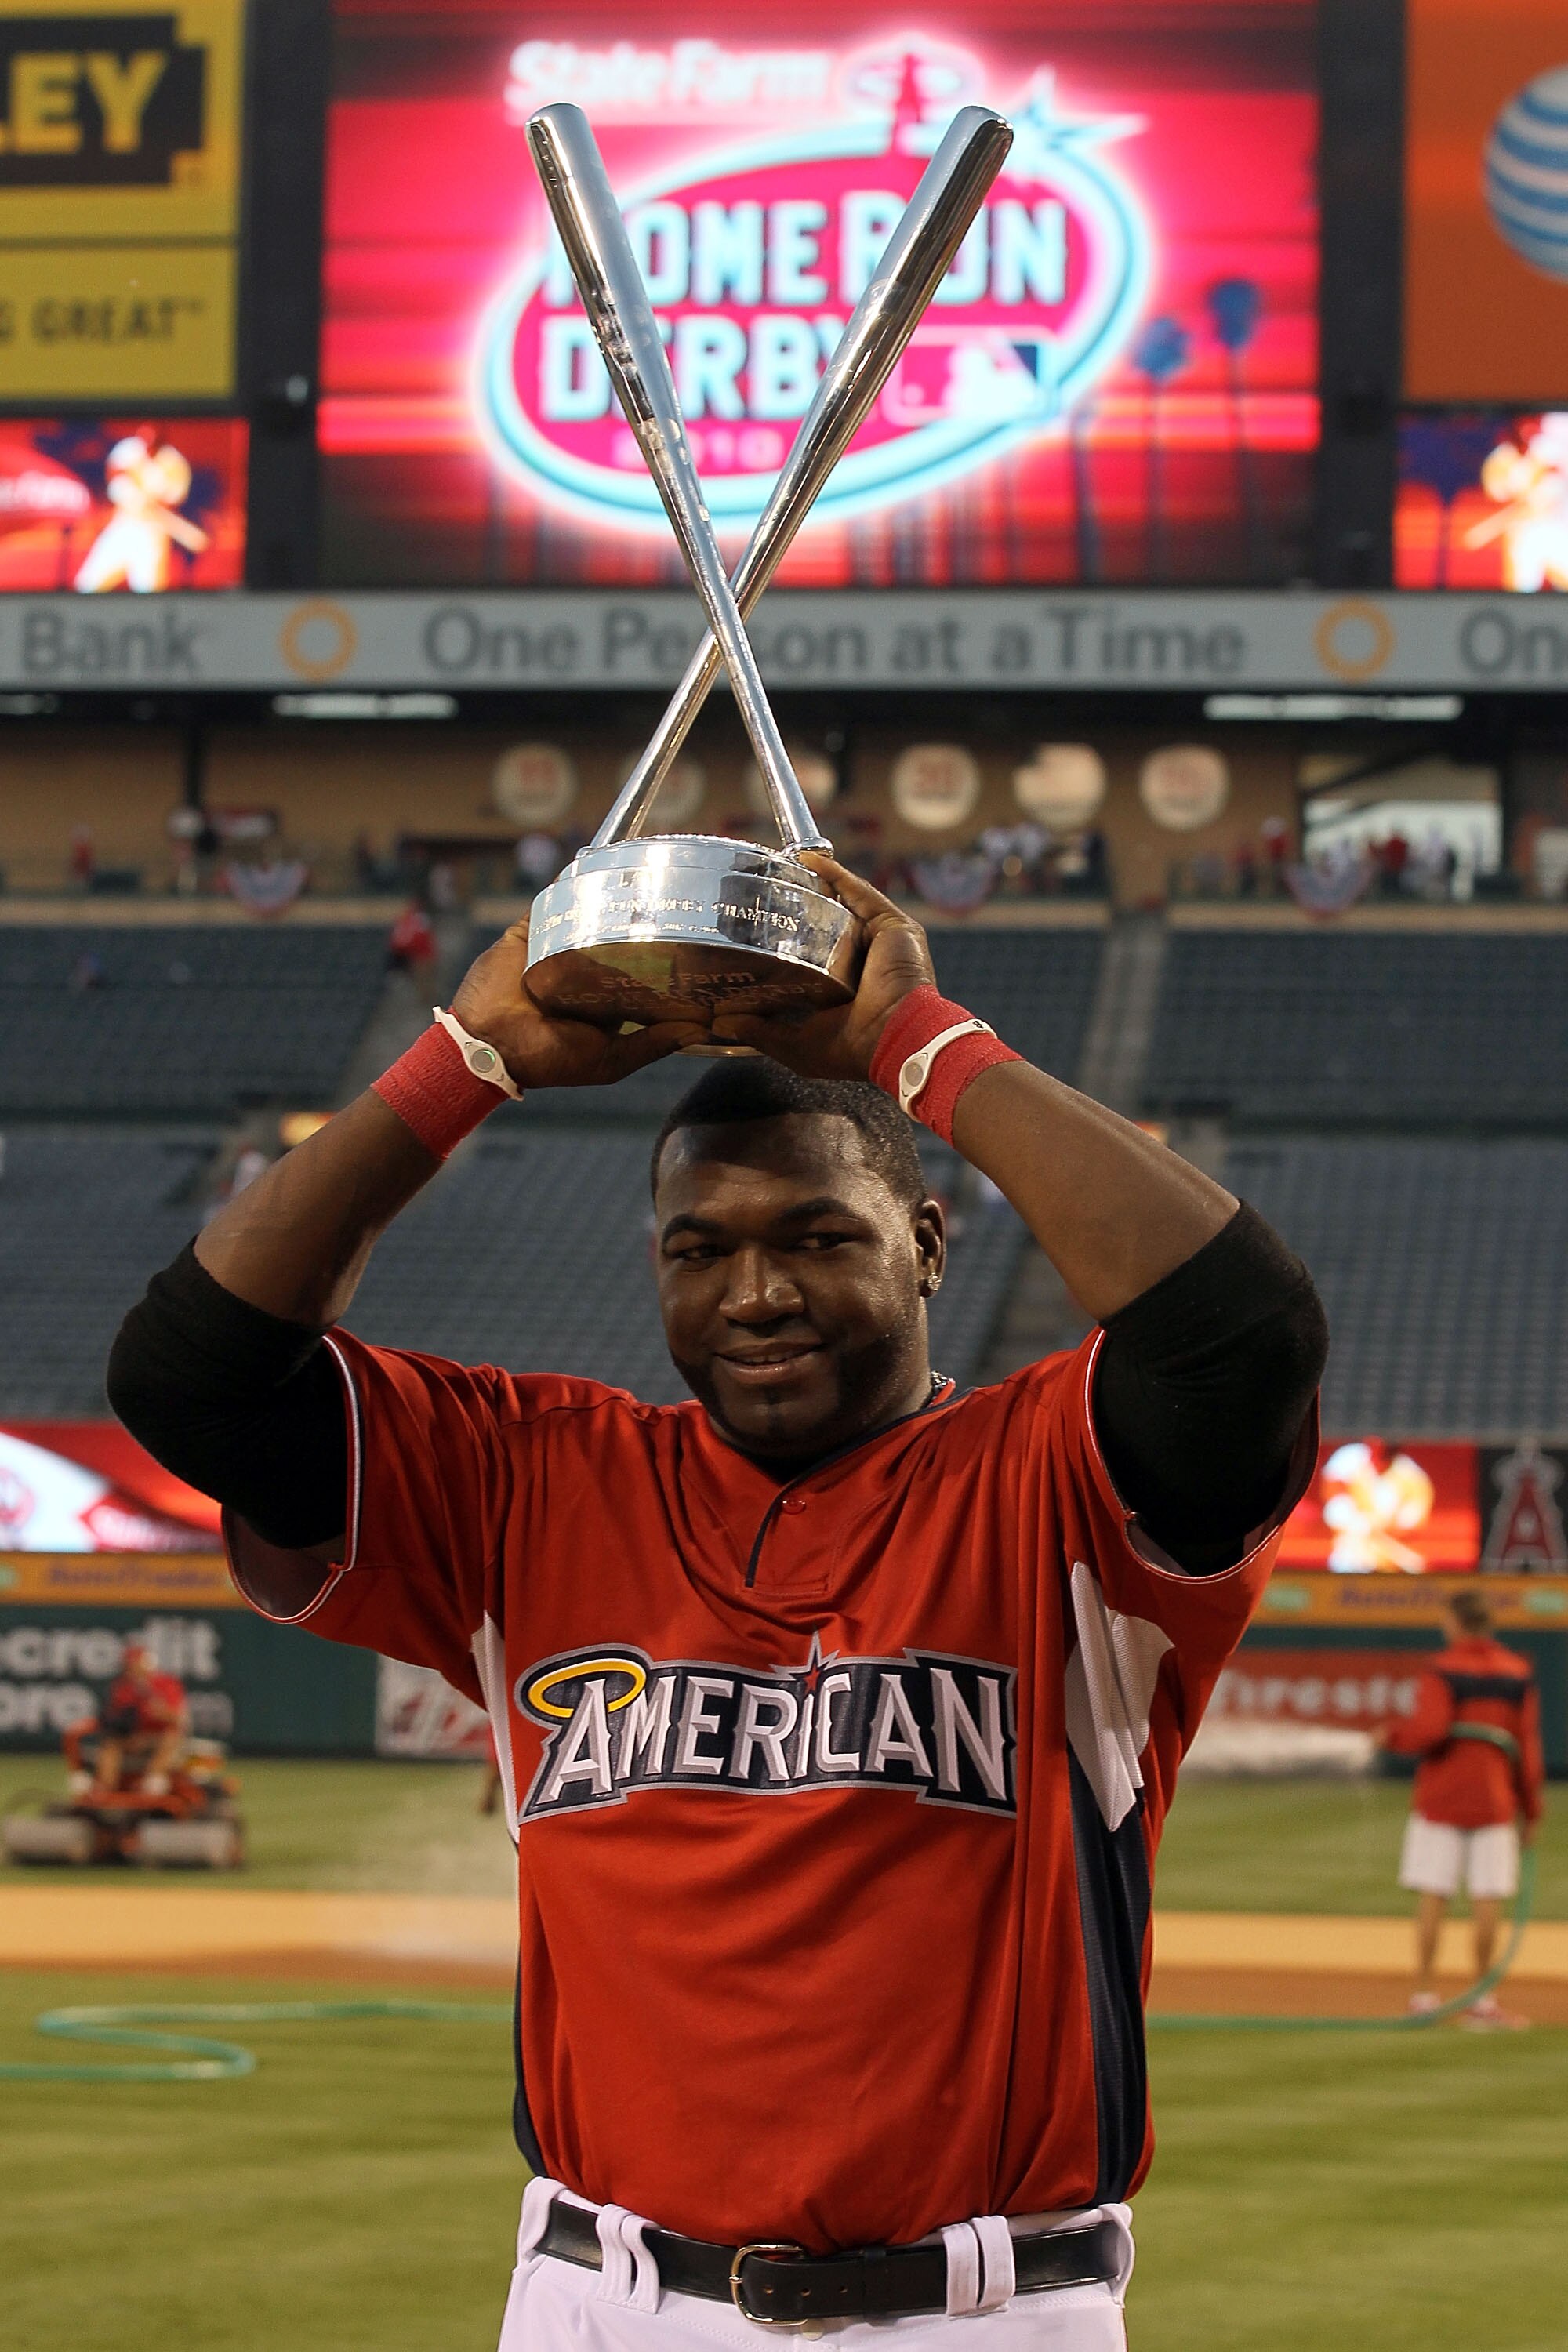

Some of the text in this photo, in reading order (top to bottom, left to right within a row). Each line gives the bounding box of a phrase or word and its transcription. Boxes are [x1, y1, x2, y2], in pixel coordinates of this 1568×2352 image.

[21, 608, 204, 674] Bank
[423, 608, 580, 676] One
[890, 616, 961, 674] at
[989, 626, 1033, 674] a
[1044, 608, 1247, 674] Time
[532, 1658, 1008, 1805] AMERICAN
